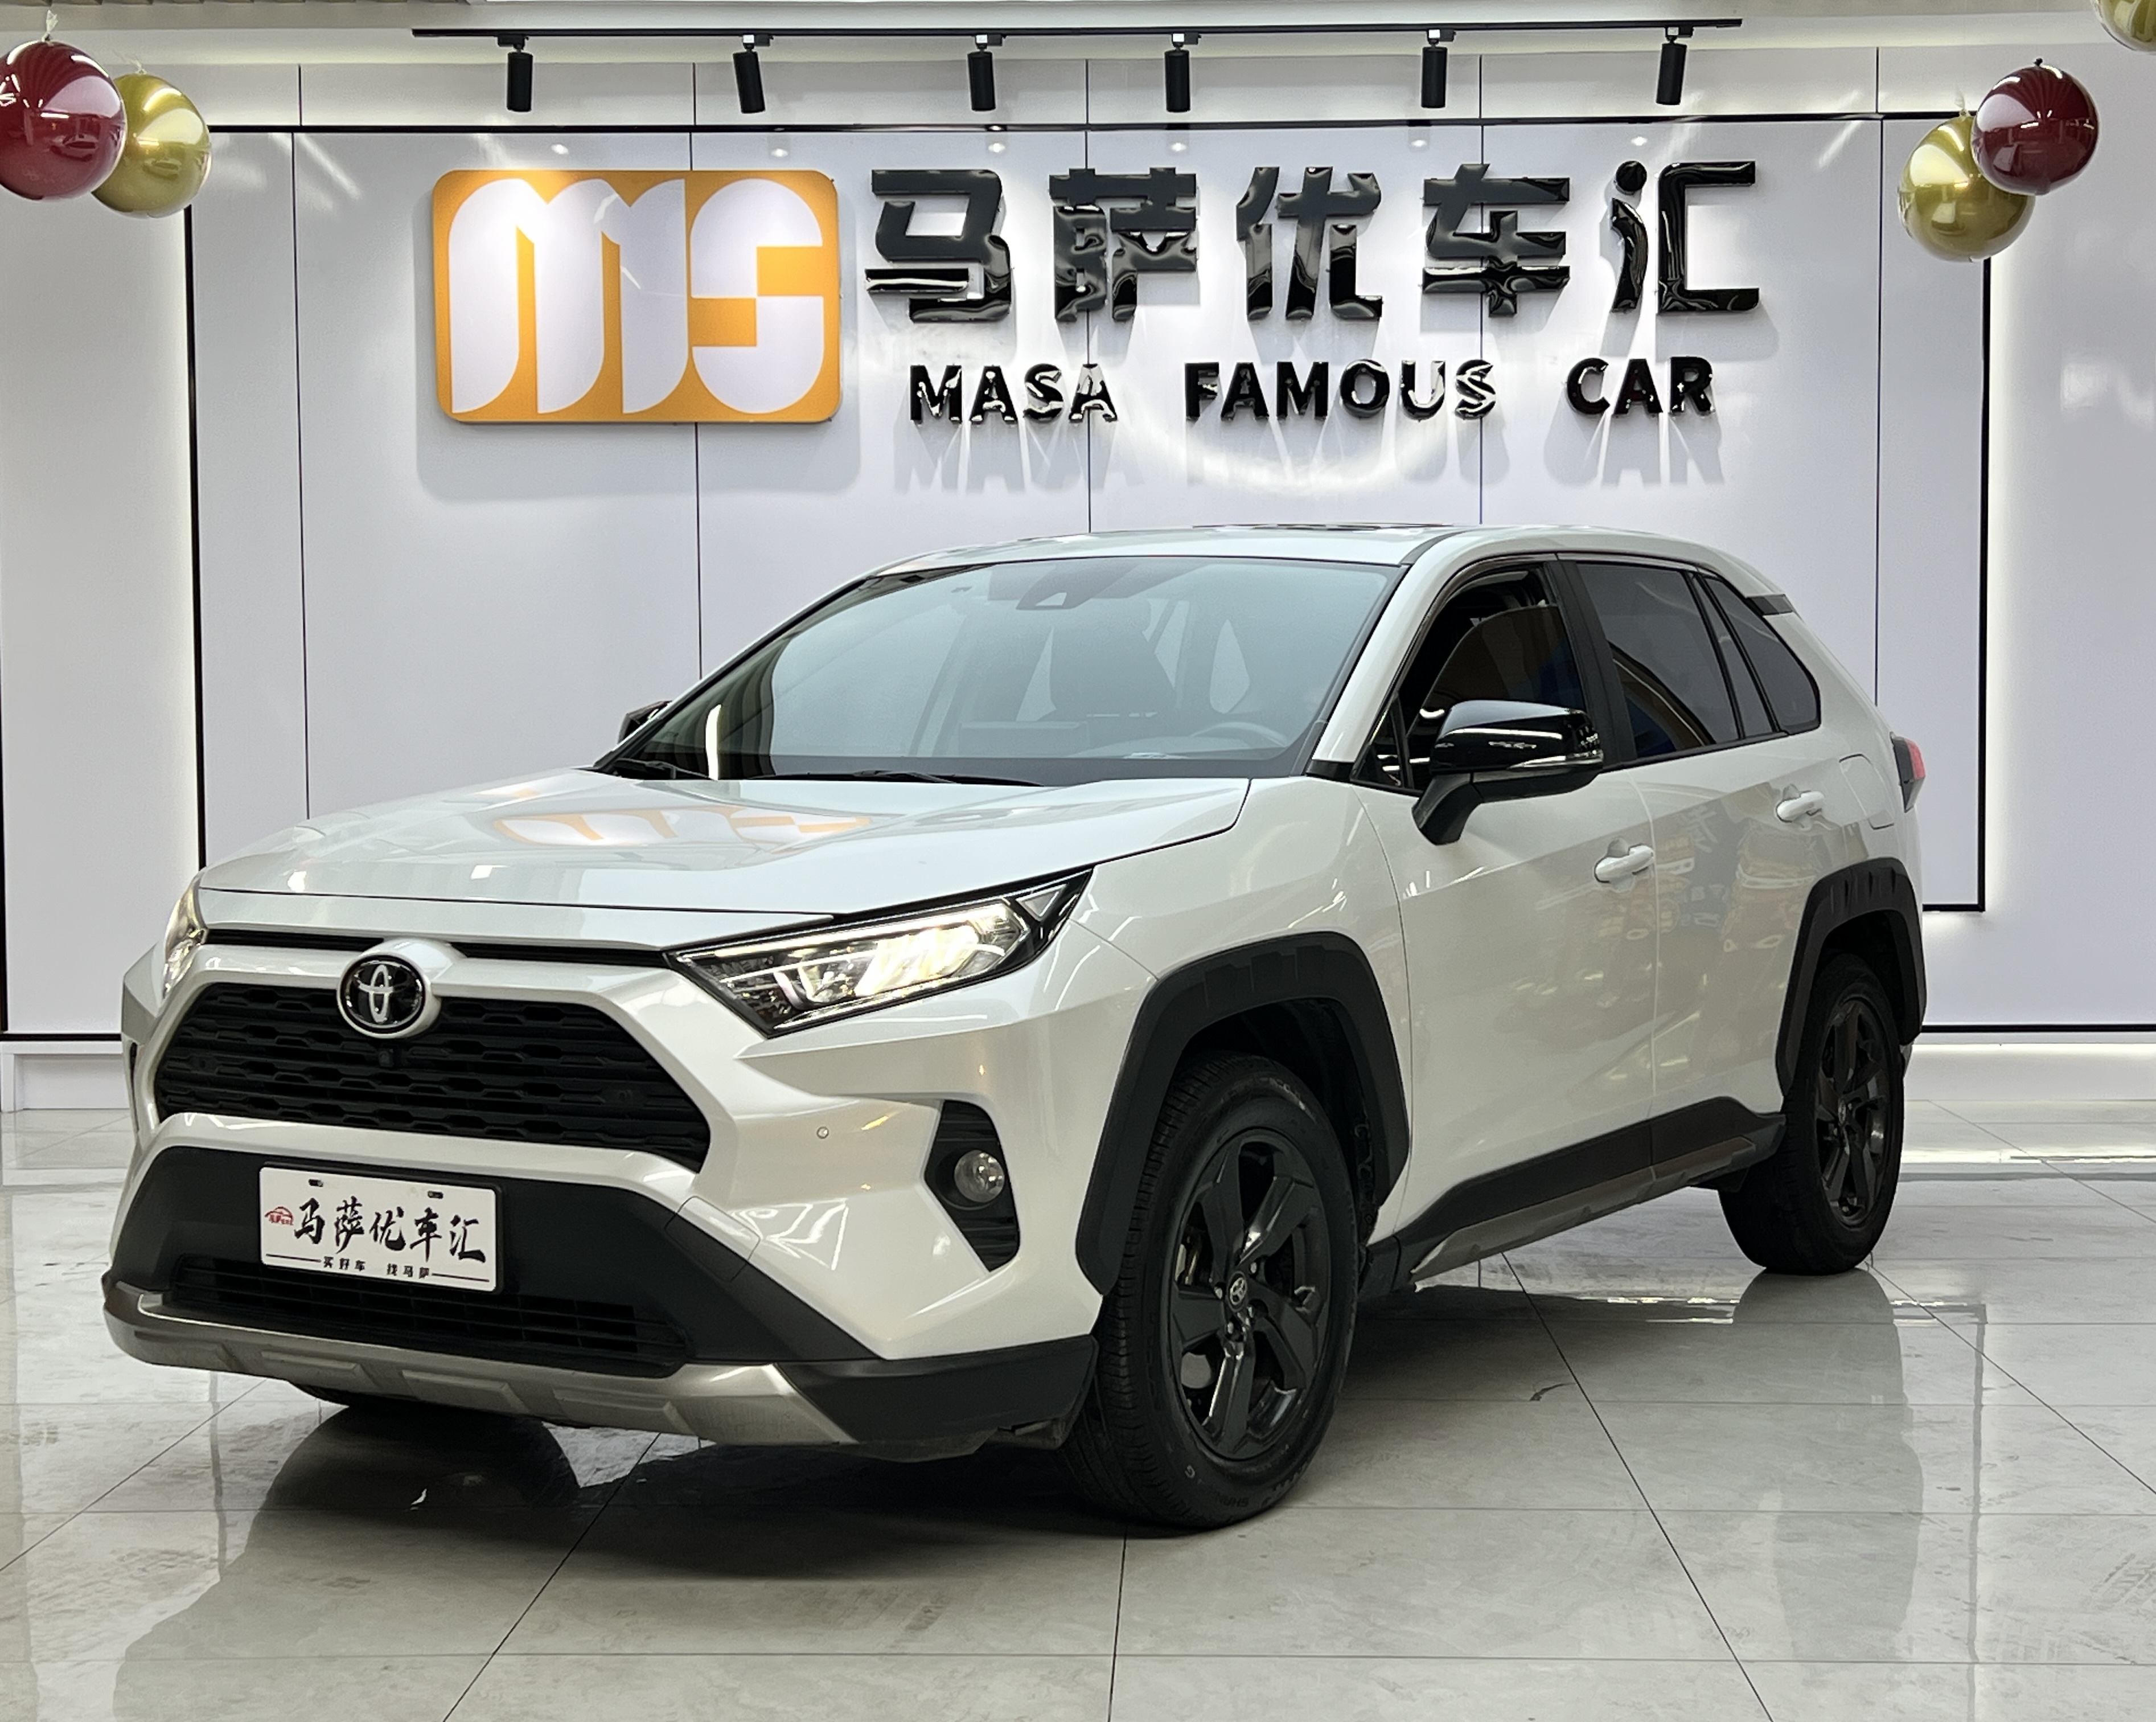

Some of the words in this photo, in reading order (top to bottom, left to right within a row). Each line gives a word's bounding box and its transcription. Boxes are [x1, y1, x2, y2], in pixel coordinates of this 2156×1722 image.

[865, 160, 1760, 323] 马萨优车汇
[910, 363, 1118, 423] MASA
[1184, 358, 1497, 421] FAMOUS
[1566, 356, 1715, 416] CAR
[294, 1196, 486, 1264] 马萨优车汇
